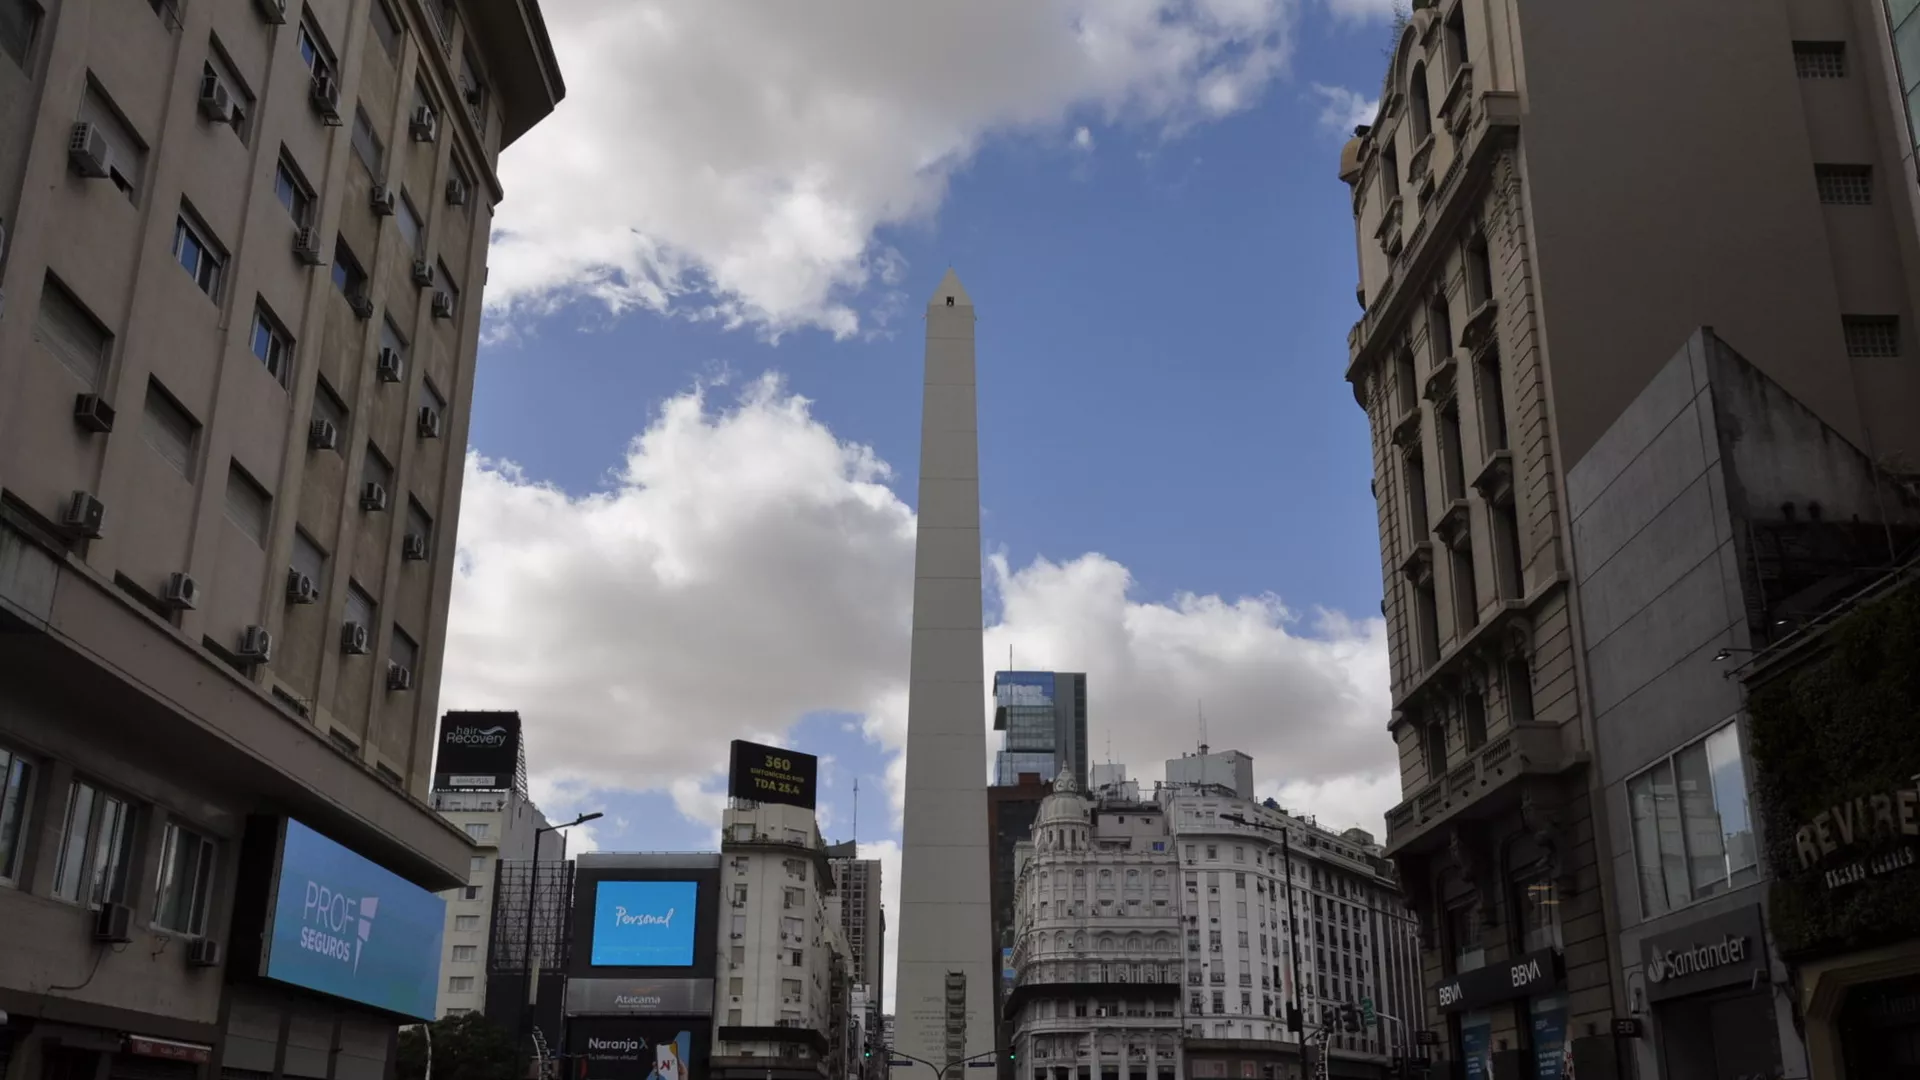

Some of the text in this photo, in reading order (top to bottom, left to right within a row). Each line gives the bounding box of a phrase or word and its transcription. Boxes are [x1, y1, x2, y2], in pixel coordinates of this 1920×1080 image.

[446, 732, 507, 747] Recovery
[456, 725, 478, 735] hair
[764, 754, 792, 771] 360
[754, 777, 776, 792] TDA
[302, 880, 356, 934] PROF
[615, 905, 674, 929] Personal
[300, 925, 351, 962] SEGUROS
[1665, 934, 1745, 979] Santander
[1511, 958, 1541, 987] BBVA
[614, 995, 661, 1004] Atacama
[1439, 982, 1463, 1006] BBVA
